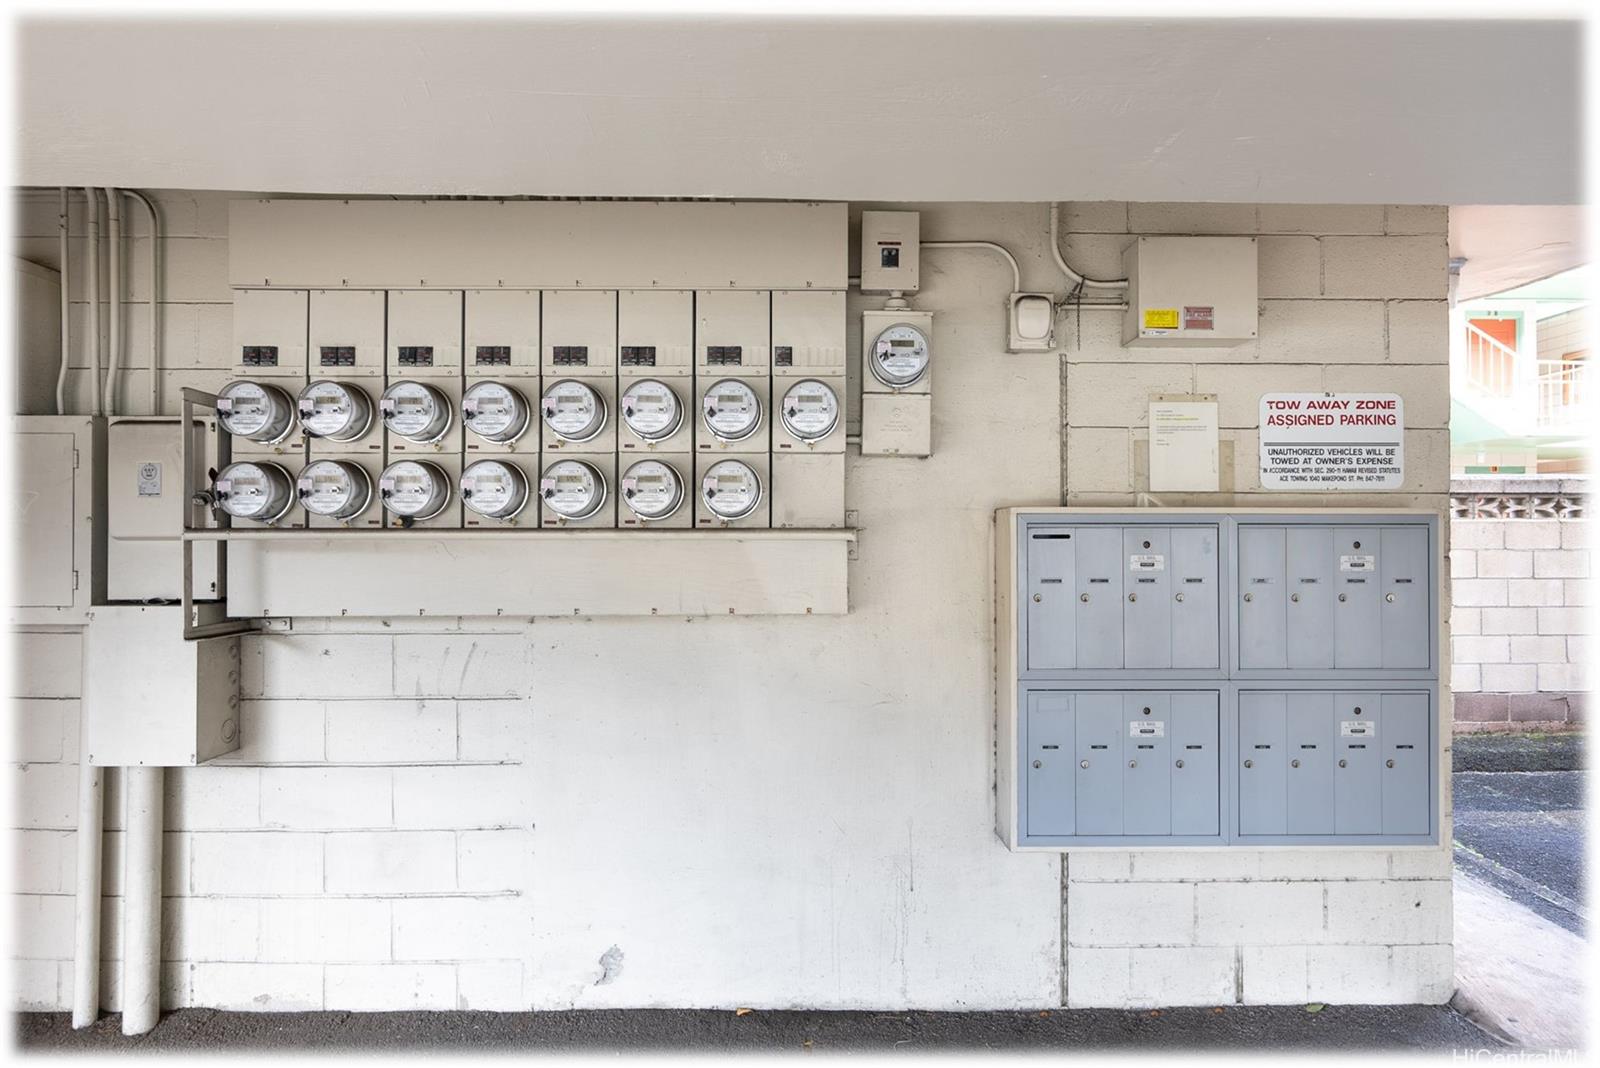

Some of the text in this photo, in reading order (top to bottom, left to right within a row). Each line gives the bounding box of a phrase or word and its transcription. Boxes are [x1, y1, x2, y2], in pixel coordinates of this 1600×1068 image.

[1266, 401, 1396, 410] TOW AWAY ZONE
[1267, 414, 1396, 426] ASSIGNED PARKING
